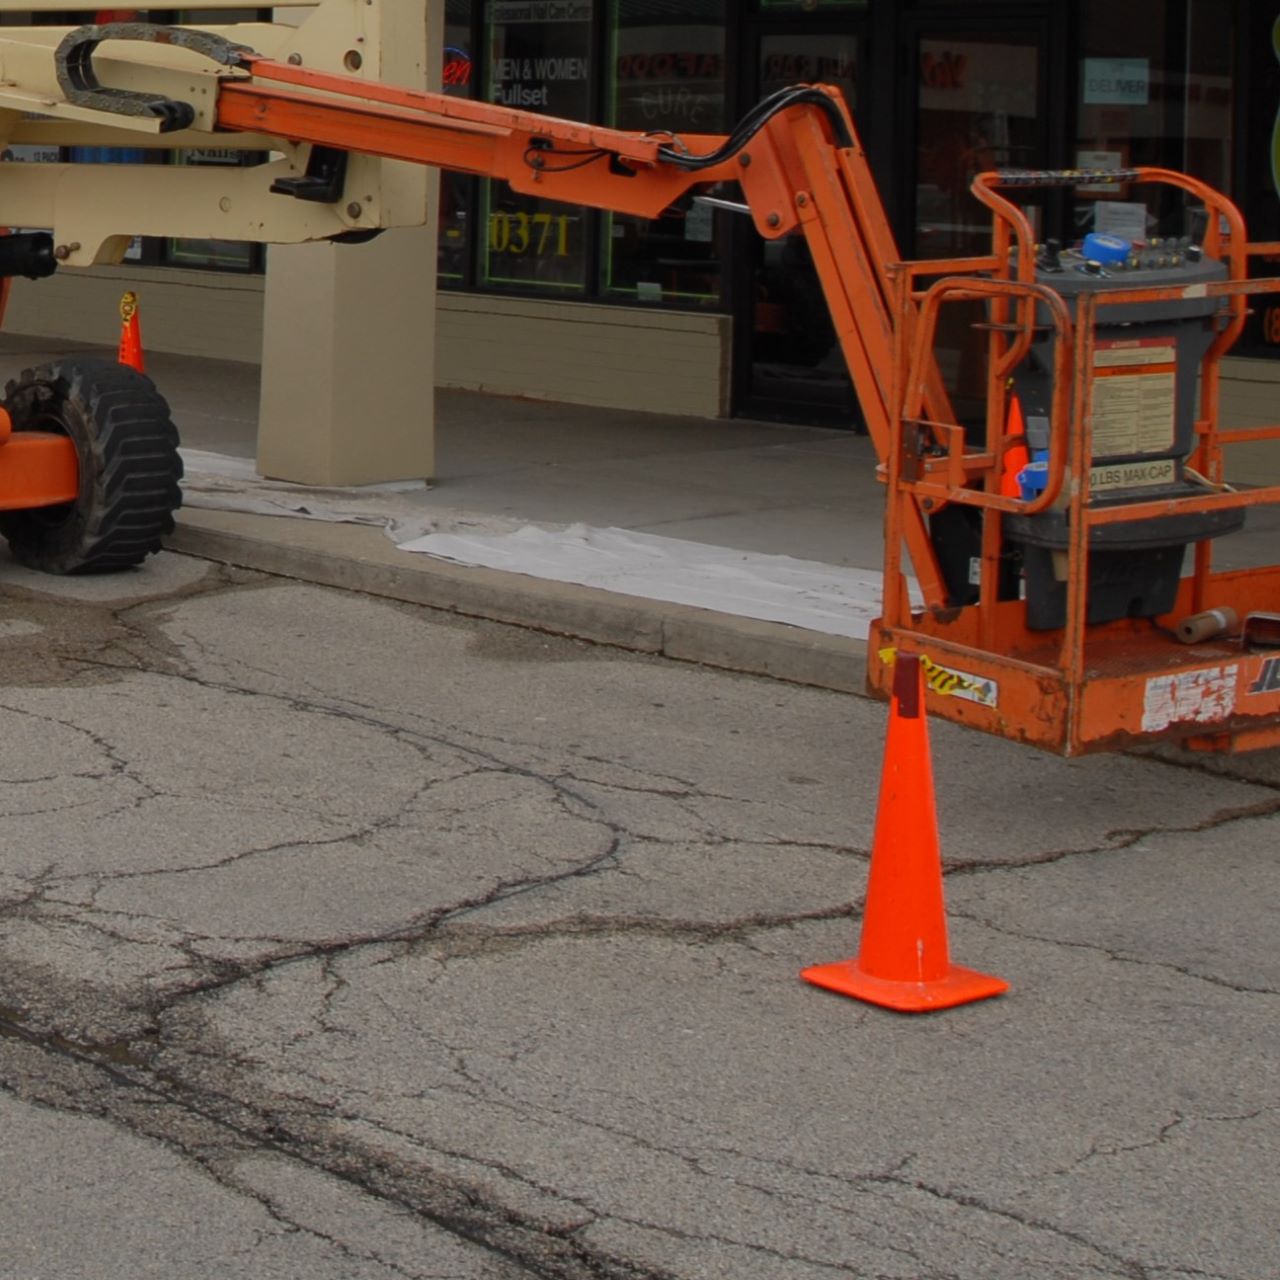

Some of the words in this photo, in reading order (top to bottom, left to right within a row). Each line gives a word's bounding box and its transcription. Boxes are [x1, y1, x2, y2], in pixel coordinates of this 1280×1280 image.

[493, 58, 521, 80] MEN
[523, 58, 532, 79] &
[534, 58, 587, 81] WOMEN
[492, 84, 549, 106] Fullset
[489, 210, 568, 256] 0371
[1099, 469, 1121, 485] LBS
[1123, 467, 1147, 482] MAX
[1149, 465, 1172, 480] CAP
